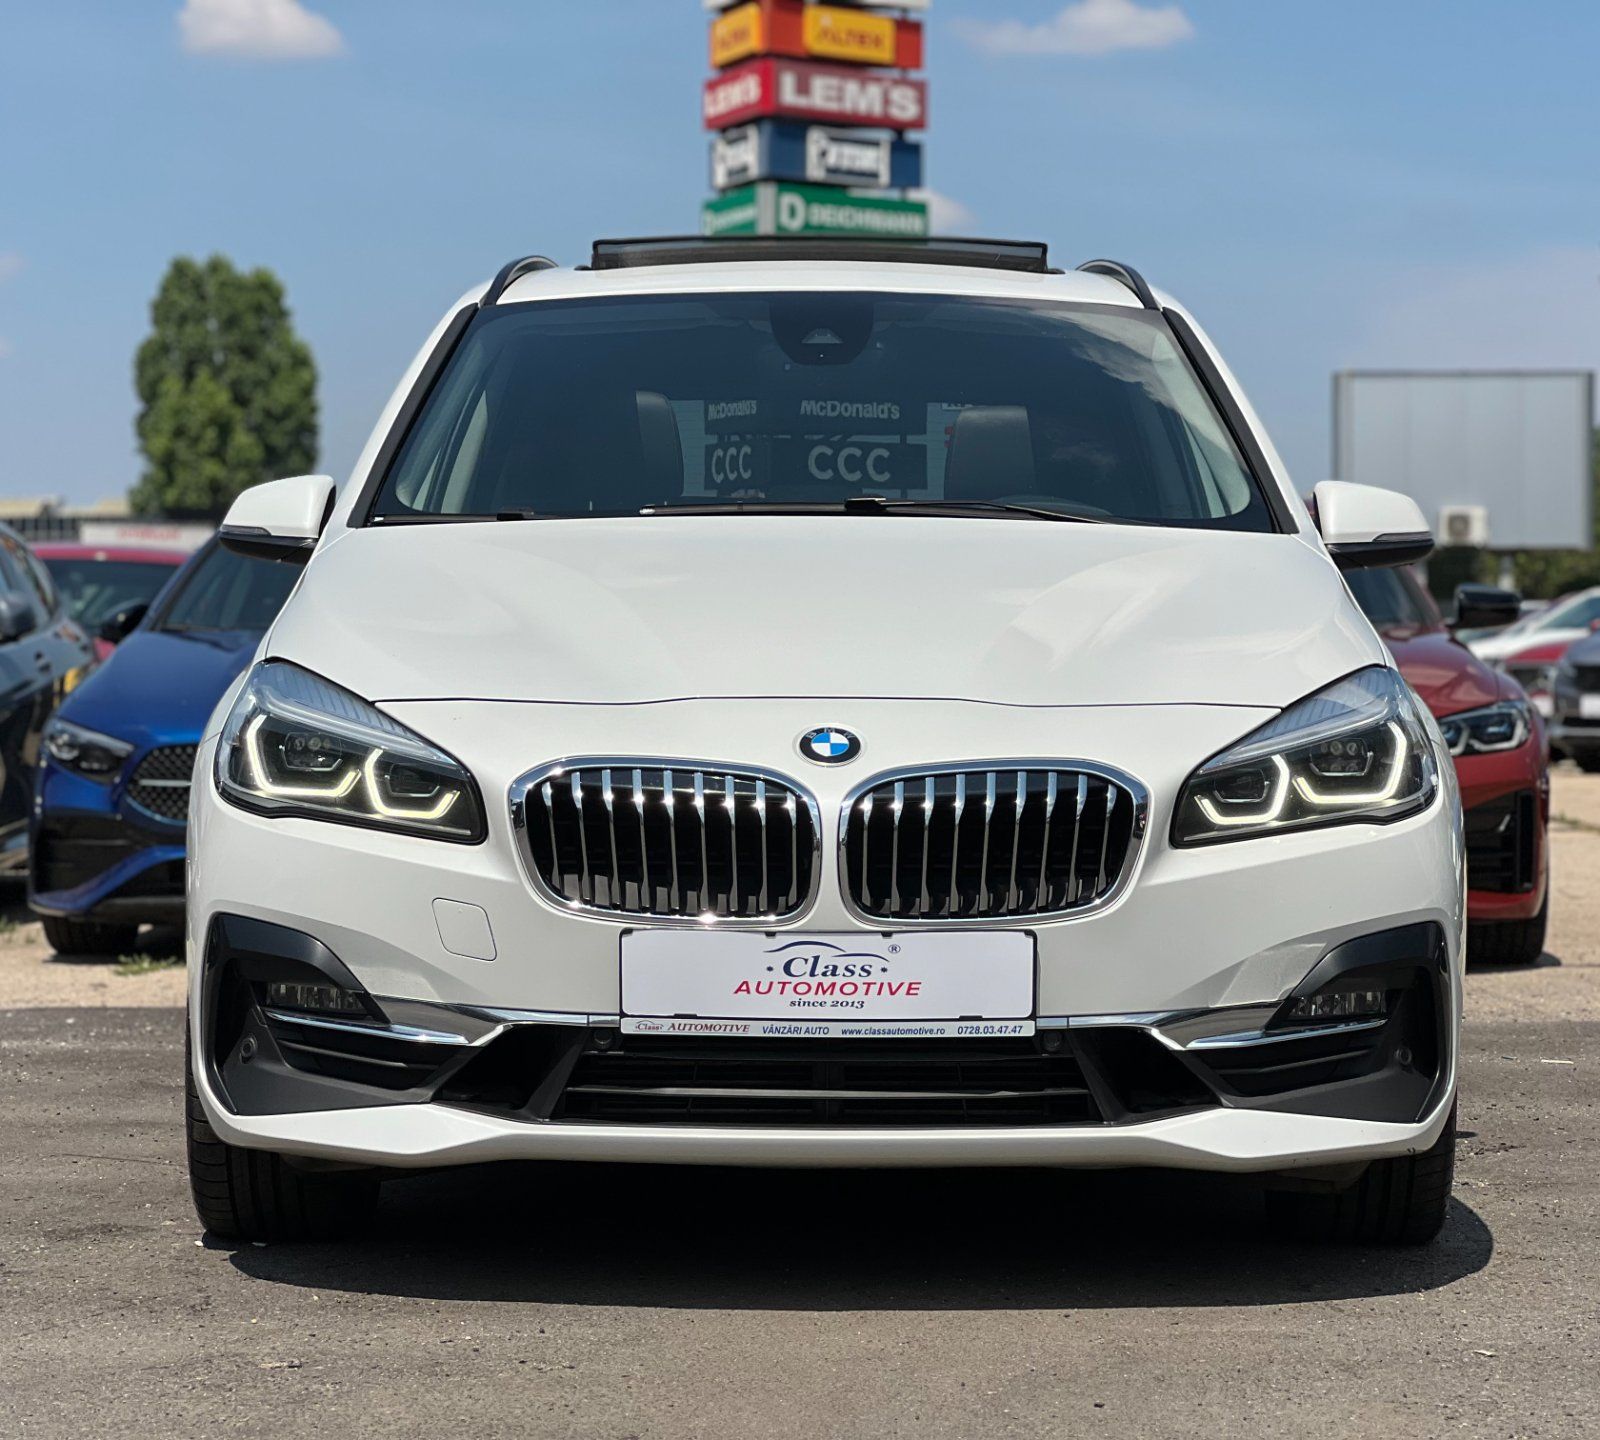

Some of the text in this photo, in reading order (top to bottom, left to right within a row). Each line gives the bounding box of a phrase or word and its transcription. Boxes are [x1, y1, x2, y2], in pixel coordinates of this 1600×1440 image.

[708, 400, 757, 421] McDonald's
[800, 400, 900, 419] McDonald's
[711, 445, 752, 484] CCC
[808, 445, 892, 482] CCC
[782, 955, 873, 978] Class
[733, 980, 922, 996] AUTOMOTIVE
[789, 998, 865, 1009] since 2013
[668, 1023, 751, 1032] AUTOMOTIVE
[804, 1026, 830, 1035] AUTO
[841, 1026, 946, 1036] www.classautomotive.ro
[957, 1026, 1023, 1035] 0728.03.47.47
